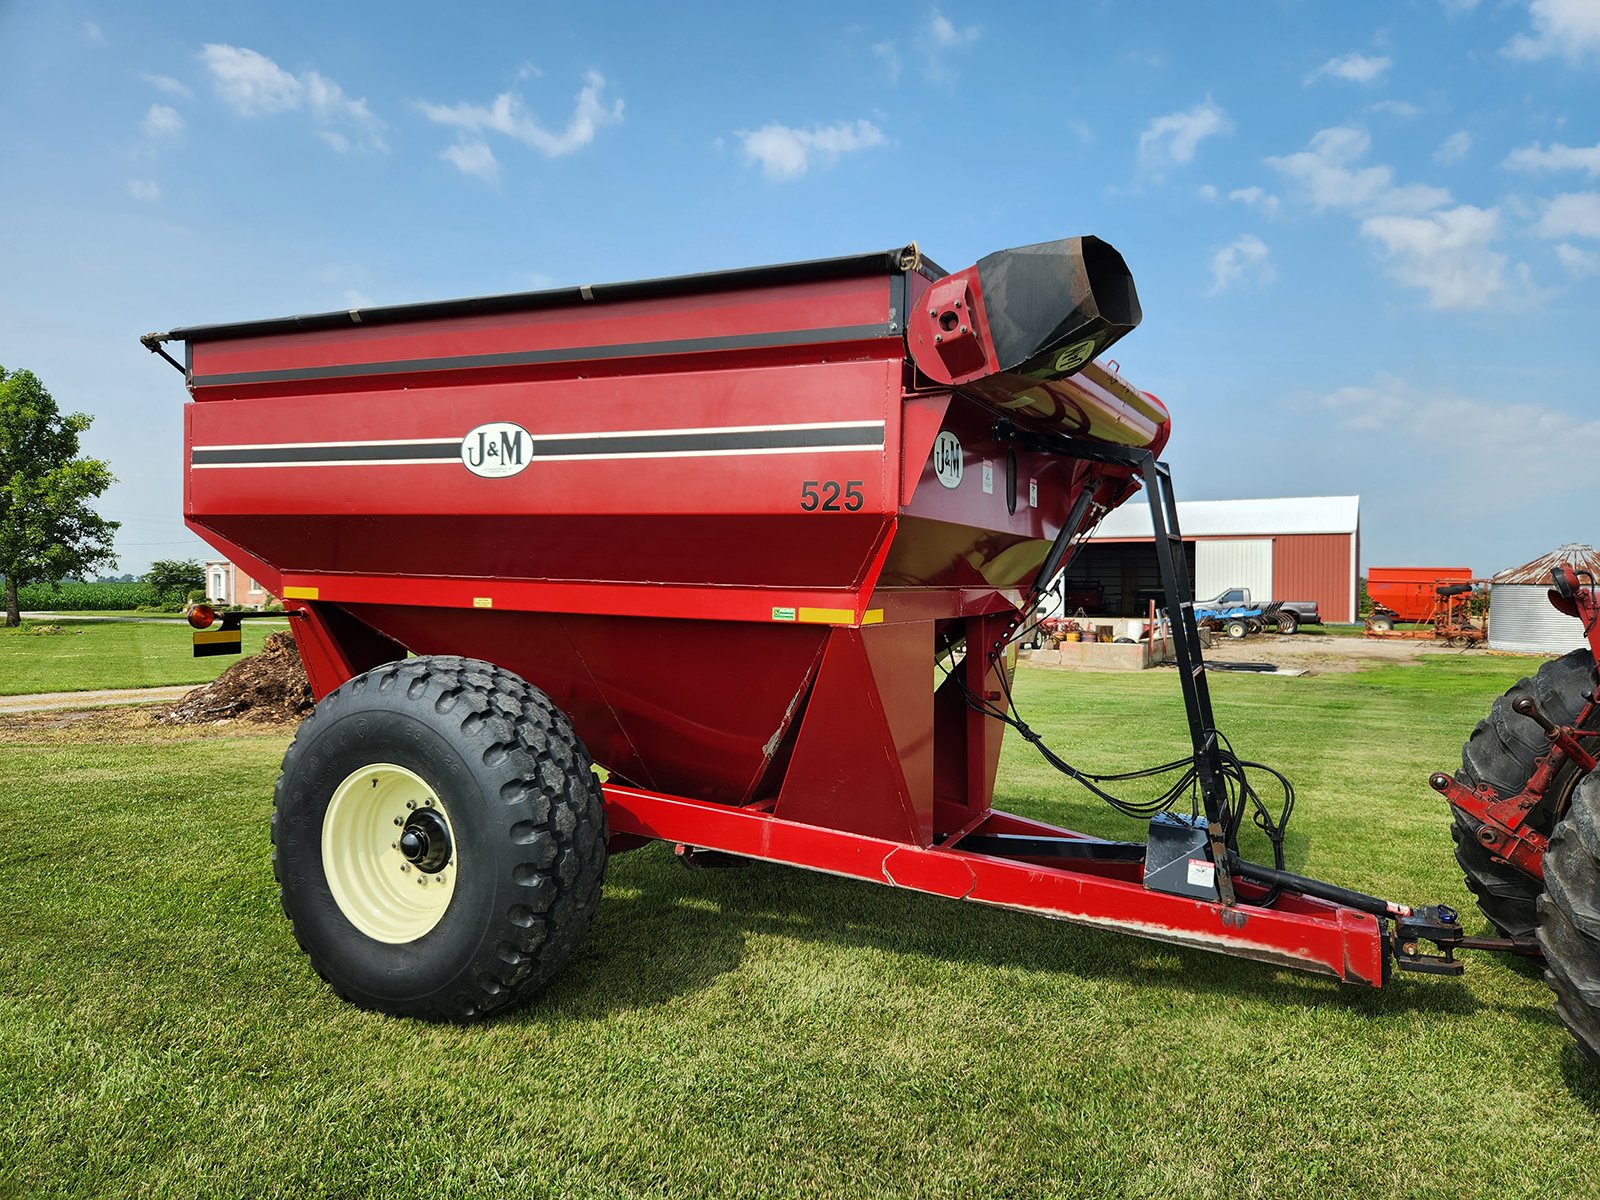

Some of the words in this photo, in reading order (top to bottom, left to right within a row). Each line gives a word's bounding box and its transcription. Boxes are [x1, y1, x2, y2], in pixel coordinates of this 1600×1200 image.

[468, 430, 524, 467] J&M
[936, 438, 960, 478] J&M
[800, 480, 864, 512] 525
